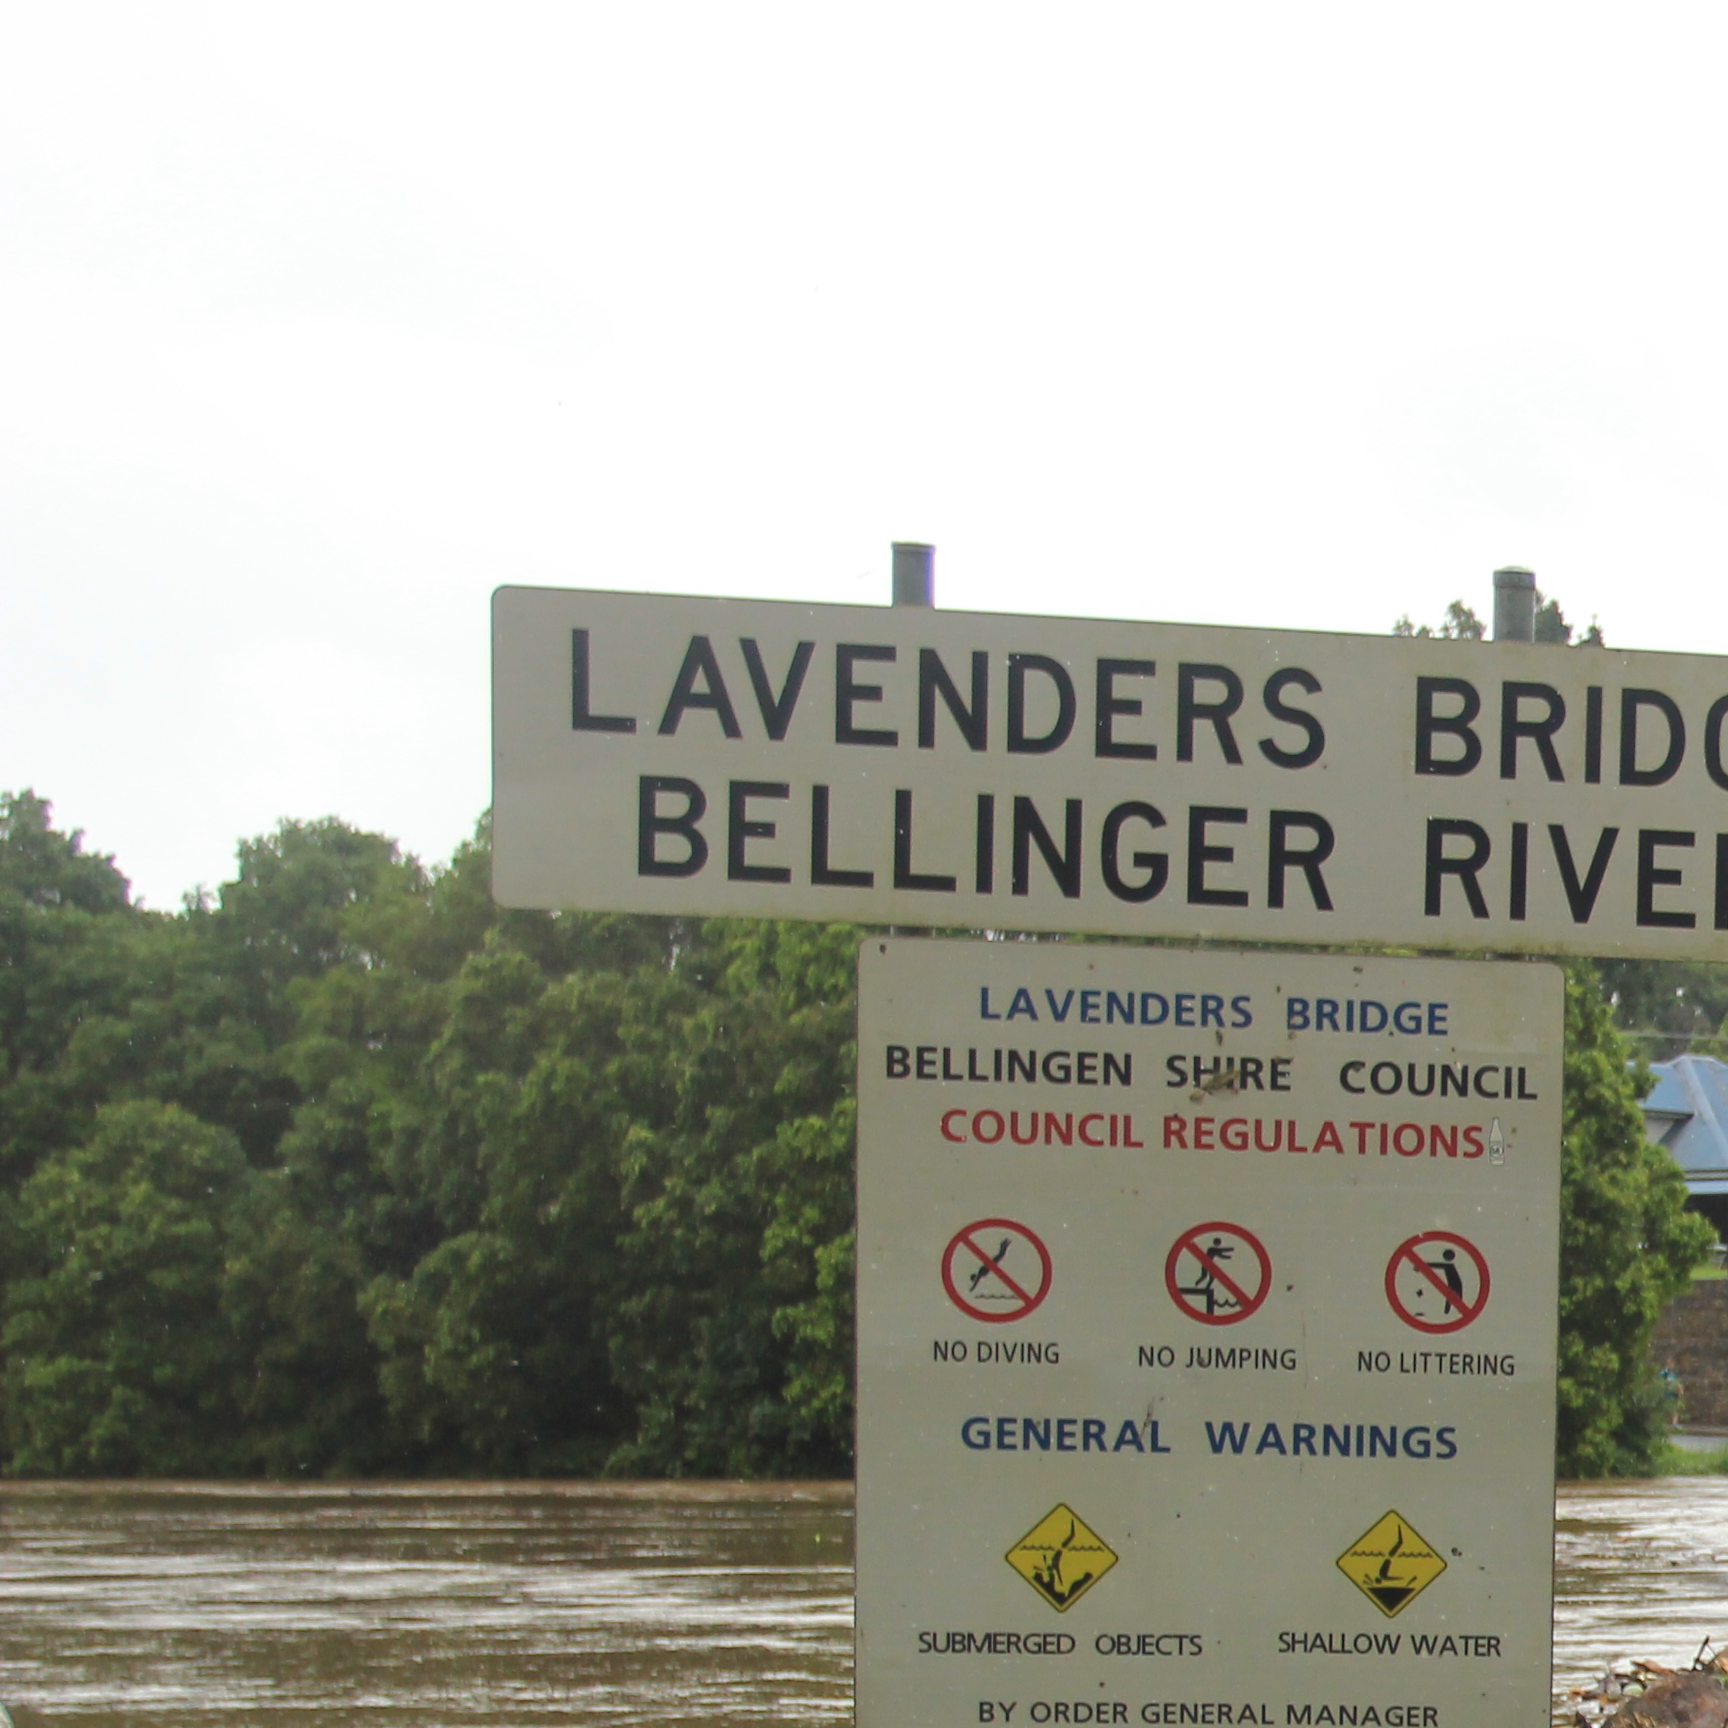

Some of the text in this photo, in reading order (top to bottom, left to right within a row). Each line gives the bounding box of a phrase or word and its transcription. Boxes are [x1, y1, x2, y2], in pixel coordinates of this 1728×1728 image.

[572, 629, 1325, 769] LAVENDERS
[638, 775, 1334, 911] BELLINGER
[981, 987, 1448, 1035] LAVENDERS BRIDGE
[886, 1045, 1537, 1099] BELLINGEN SHIRE COUNCIL
[941, 1109, 1484, 1158] COUNCIL REGULATIONS
[934, 1341, 1059, 1364] NO DIVING
[1139, 1346, 1296, 1370] NO JUMPING
[1358, 1351, 1514, 1375] NO LITTERING
[962, 1417, 1457, 1459] GENERAL WARNINGS
[919, 1632, 1202, 1655] SUBMERGED OBJECTS
[1279, 1632, 1500, 1656] SHALLOW WATER
[979, 1702, 1438, 1727] BY ORDER GENERAL MANAGER
